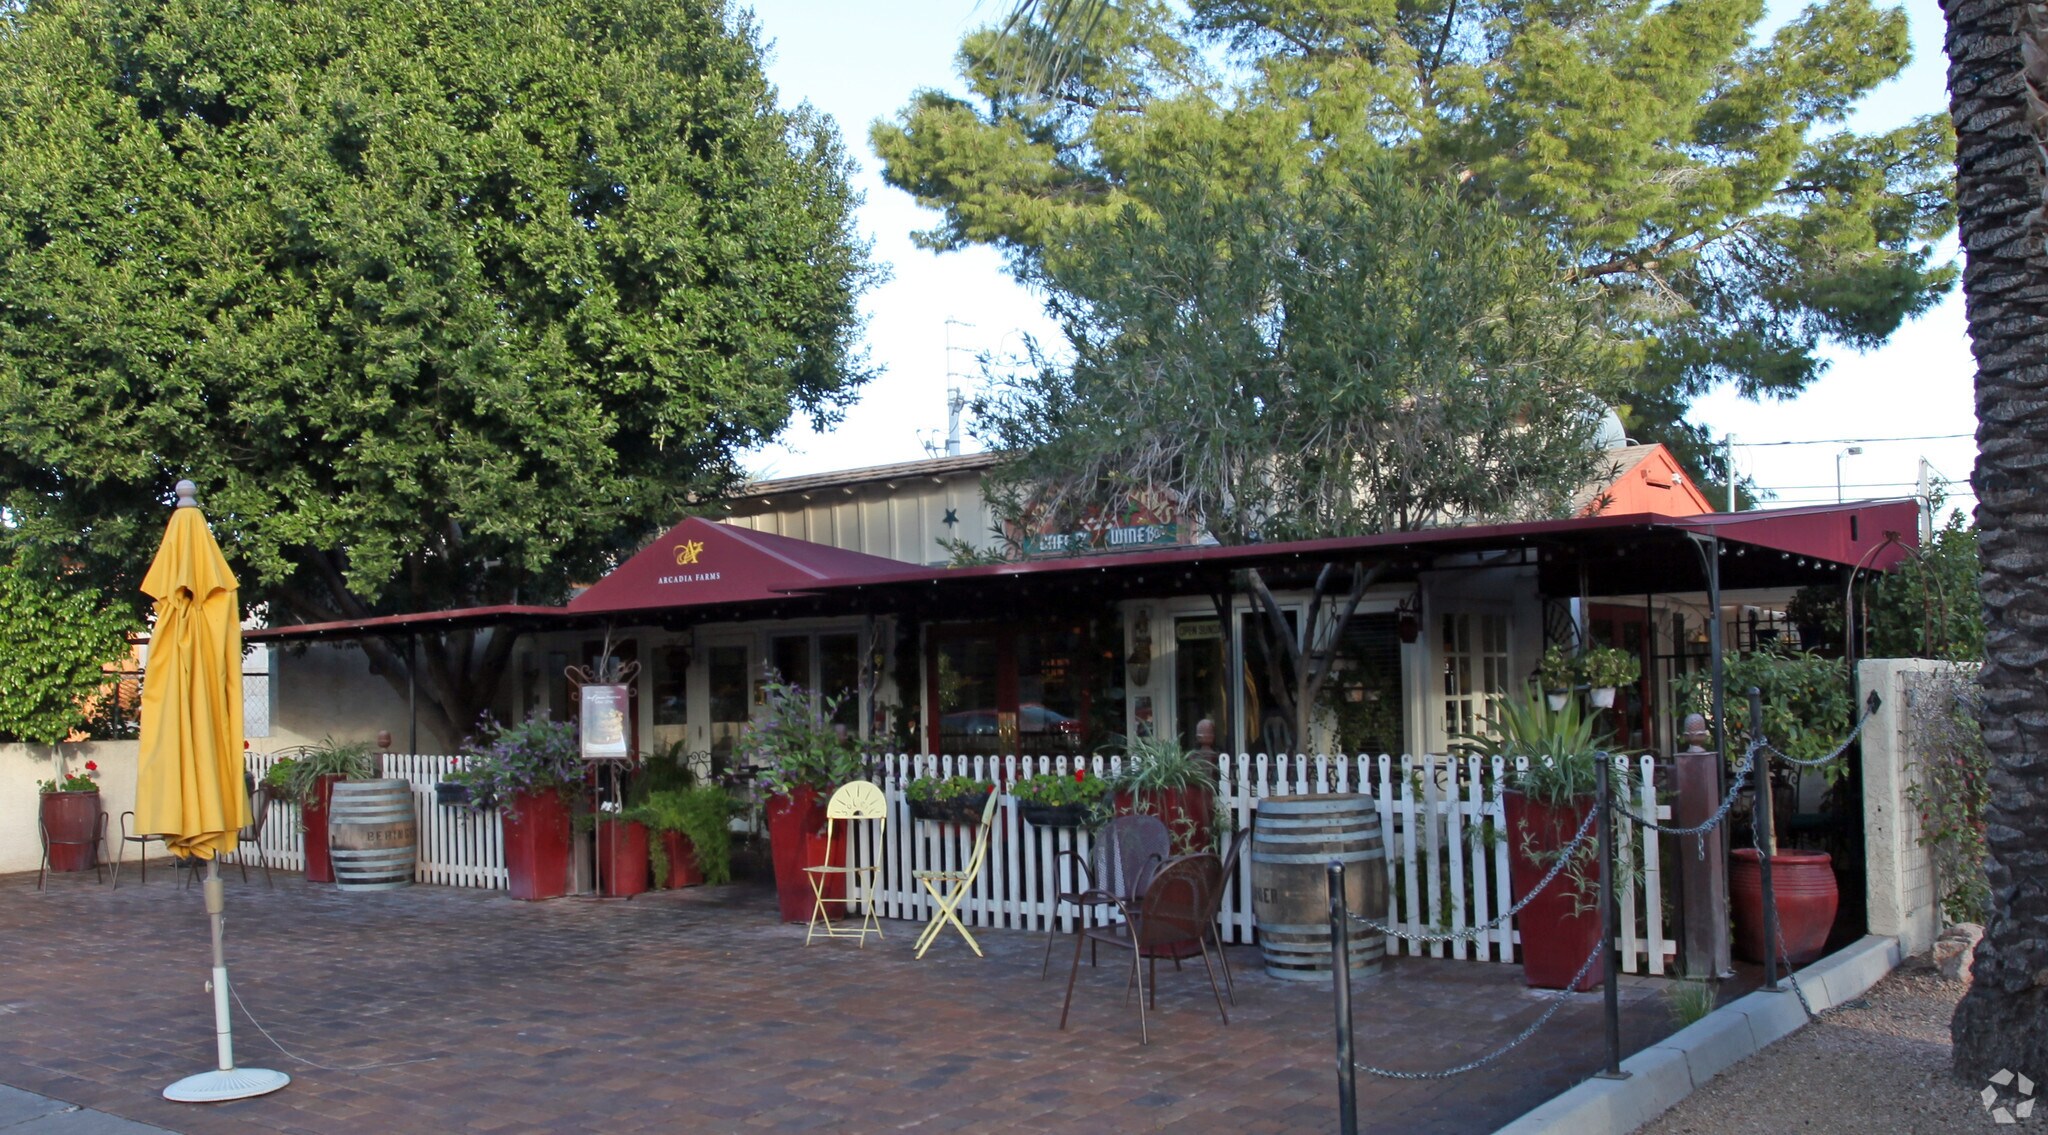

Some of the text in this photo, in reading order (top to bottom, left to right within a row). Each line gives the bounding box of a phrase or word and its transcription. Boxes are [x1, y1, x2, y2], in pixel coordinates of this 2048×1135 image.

[1111, 526, 1145, 545] WINE
[658, 571, 721, 585] ARCADIA FARMS
